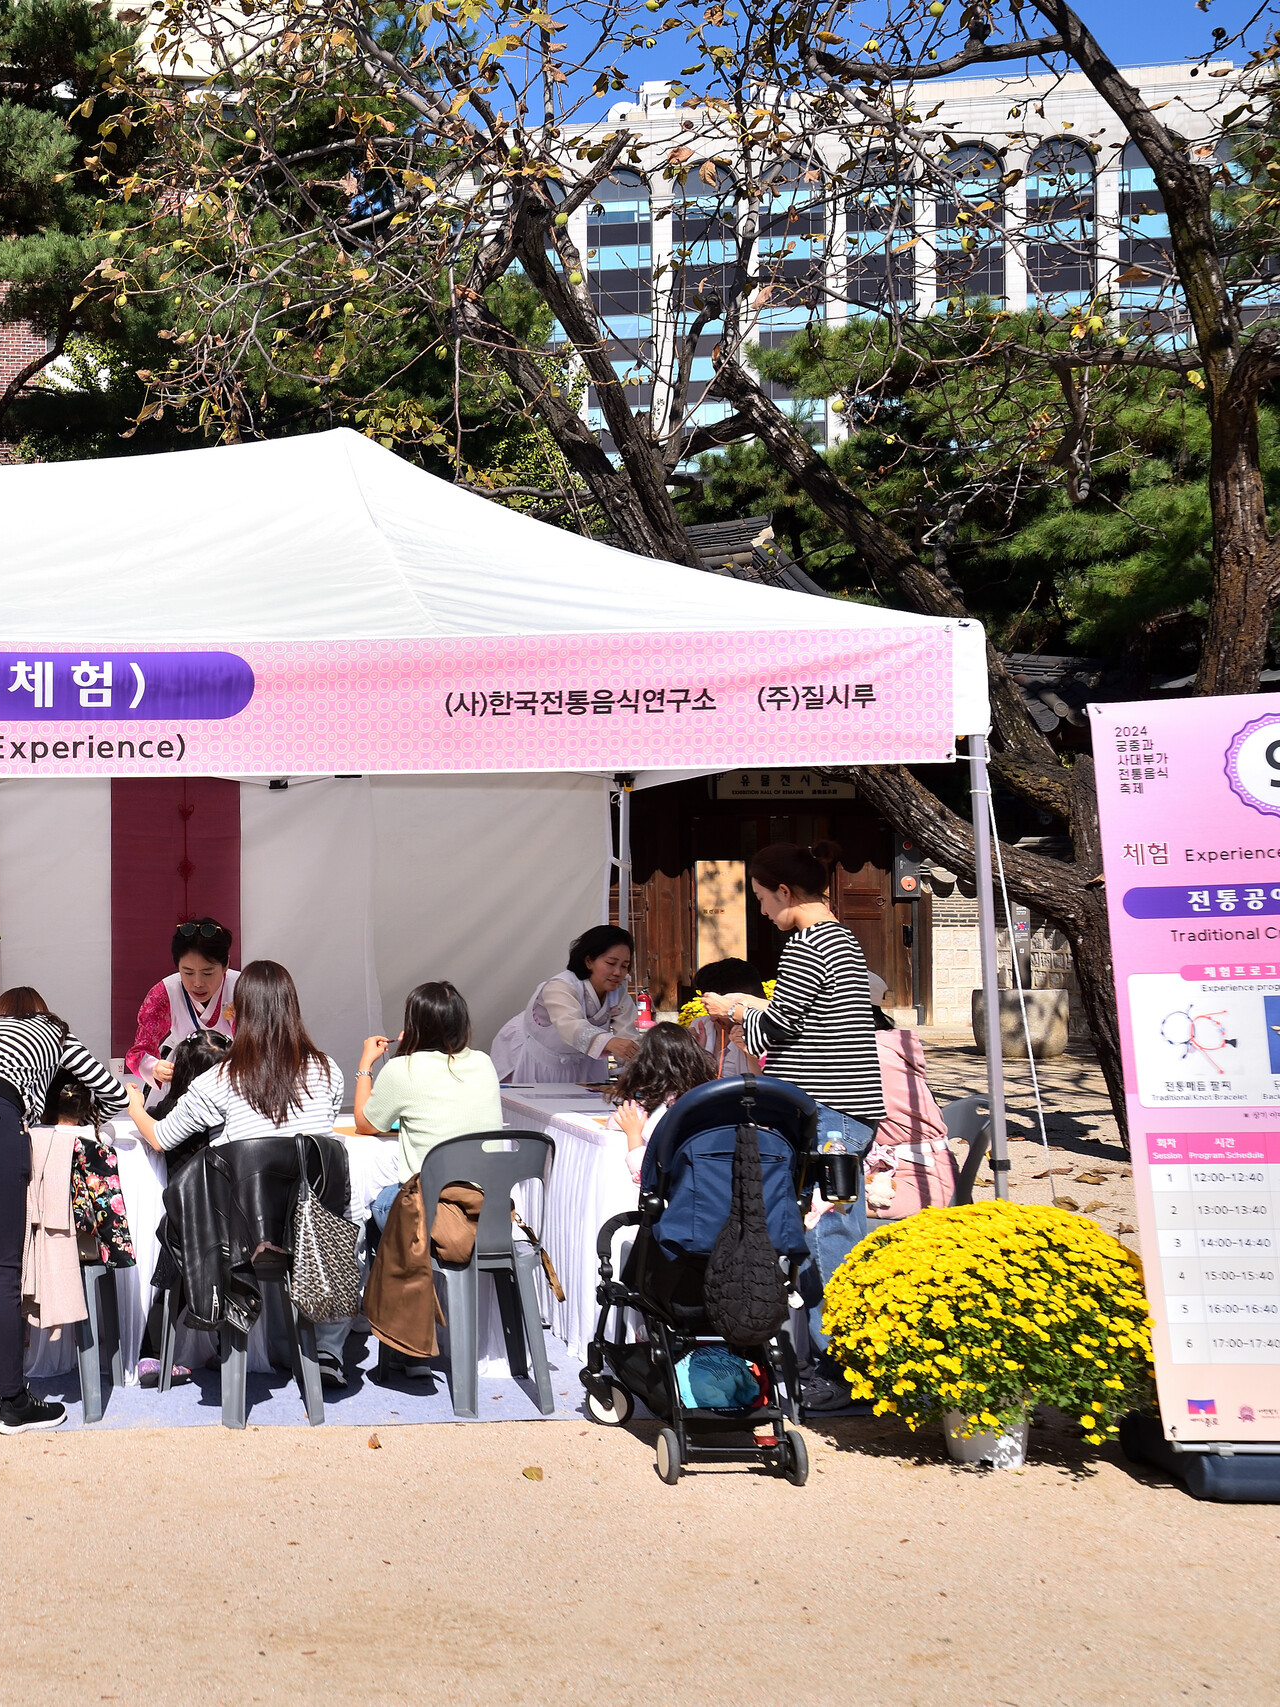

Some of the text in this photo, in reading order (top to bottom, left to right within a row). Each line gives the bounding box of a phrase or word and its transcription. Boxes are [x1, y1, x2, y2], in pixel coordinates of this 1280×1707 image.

[445, 683, 877, 718] (사)한국전통음식연구소 (주)질시루
[1114, 726, 1148, 738] 2024
[1115, 739, 1155, 753] 궁중과
[1117, 753, 1169, 767] 사대부가
[1118, 767, 1169, 781] 전통음식
[1119, 782, 1145, 795] 축제
[1122, 842, 1169, 866] 체험
[1170, 927, 1260, 943] Traditional
[1202, 984, 1255, 993] Experience
[1214, 1093, 1248, 1101] Bracelet
[1152, 1151, 1183, 1160] Session
[1188, 1151, 1265, 1161] Program Schedule
[1167, 1173, 1173, 1182] 1
[1171, 1205, 1178, 1215] 2
[1174, 1238, 1182, 1248] 3
[1178, 1271, 1186, 1280] 4
[1181, 1305, 1189, 1314] 5
[1186, 1338, 1194, 1349] 6
